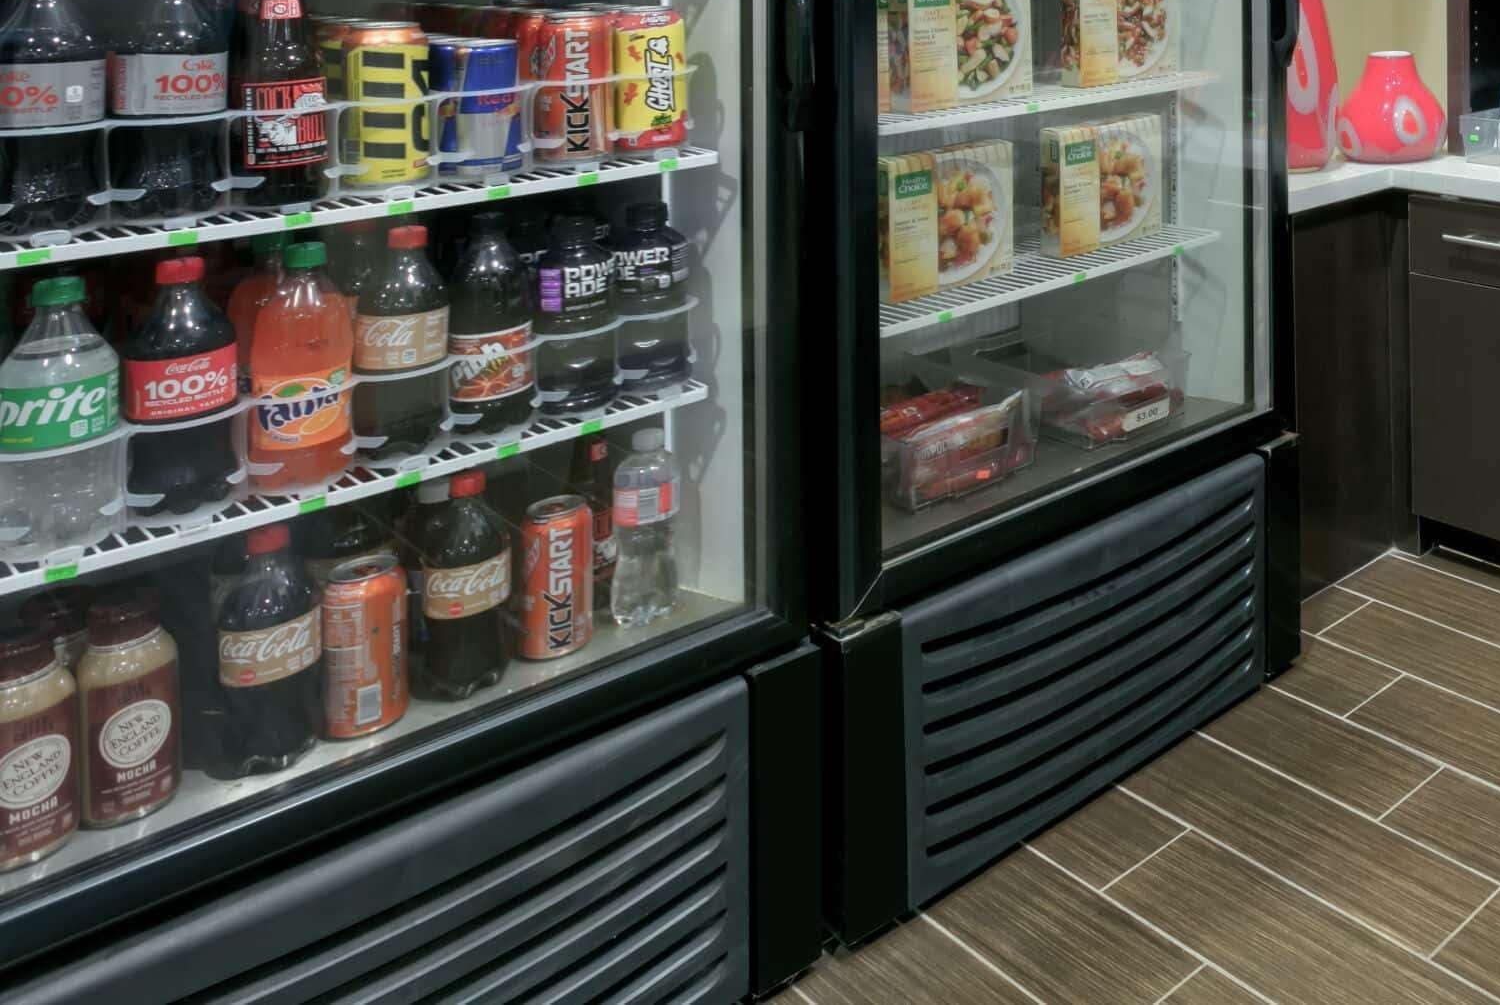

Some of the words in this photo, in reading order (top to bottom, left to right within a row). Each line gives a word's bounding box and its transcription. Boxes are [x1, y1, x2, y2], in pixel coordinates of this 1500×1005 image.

[0, 84, 59, 108] 0%
[155, 72, 225, 95] 100%
[566, 29, 591, 153] KICKSTART
[617, 246, 671, 267] OWER
[144, 367, 228, 401] 100%
[0, 385, 107, 431] prite
[548, 527, 574, 651] KICKSTART
[220, 616, 312, 662] Coca-Cola
[117, 713, 145, 732] NEW
[13, 750, 45, 772] NEW
[116, 760, 157, 783] MOCHA
[9, 796, 59, 825] MOCHA
